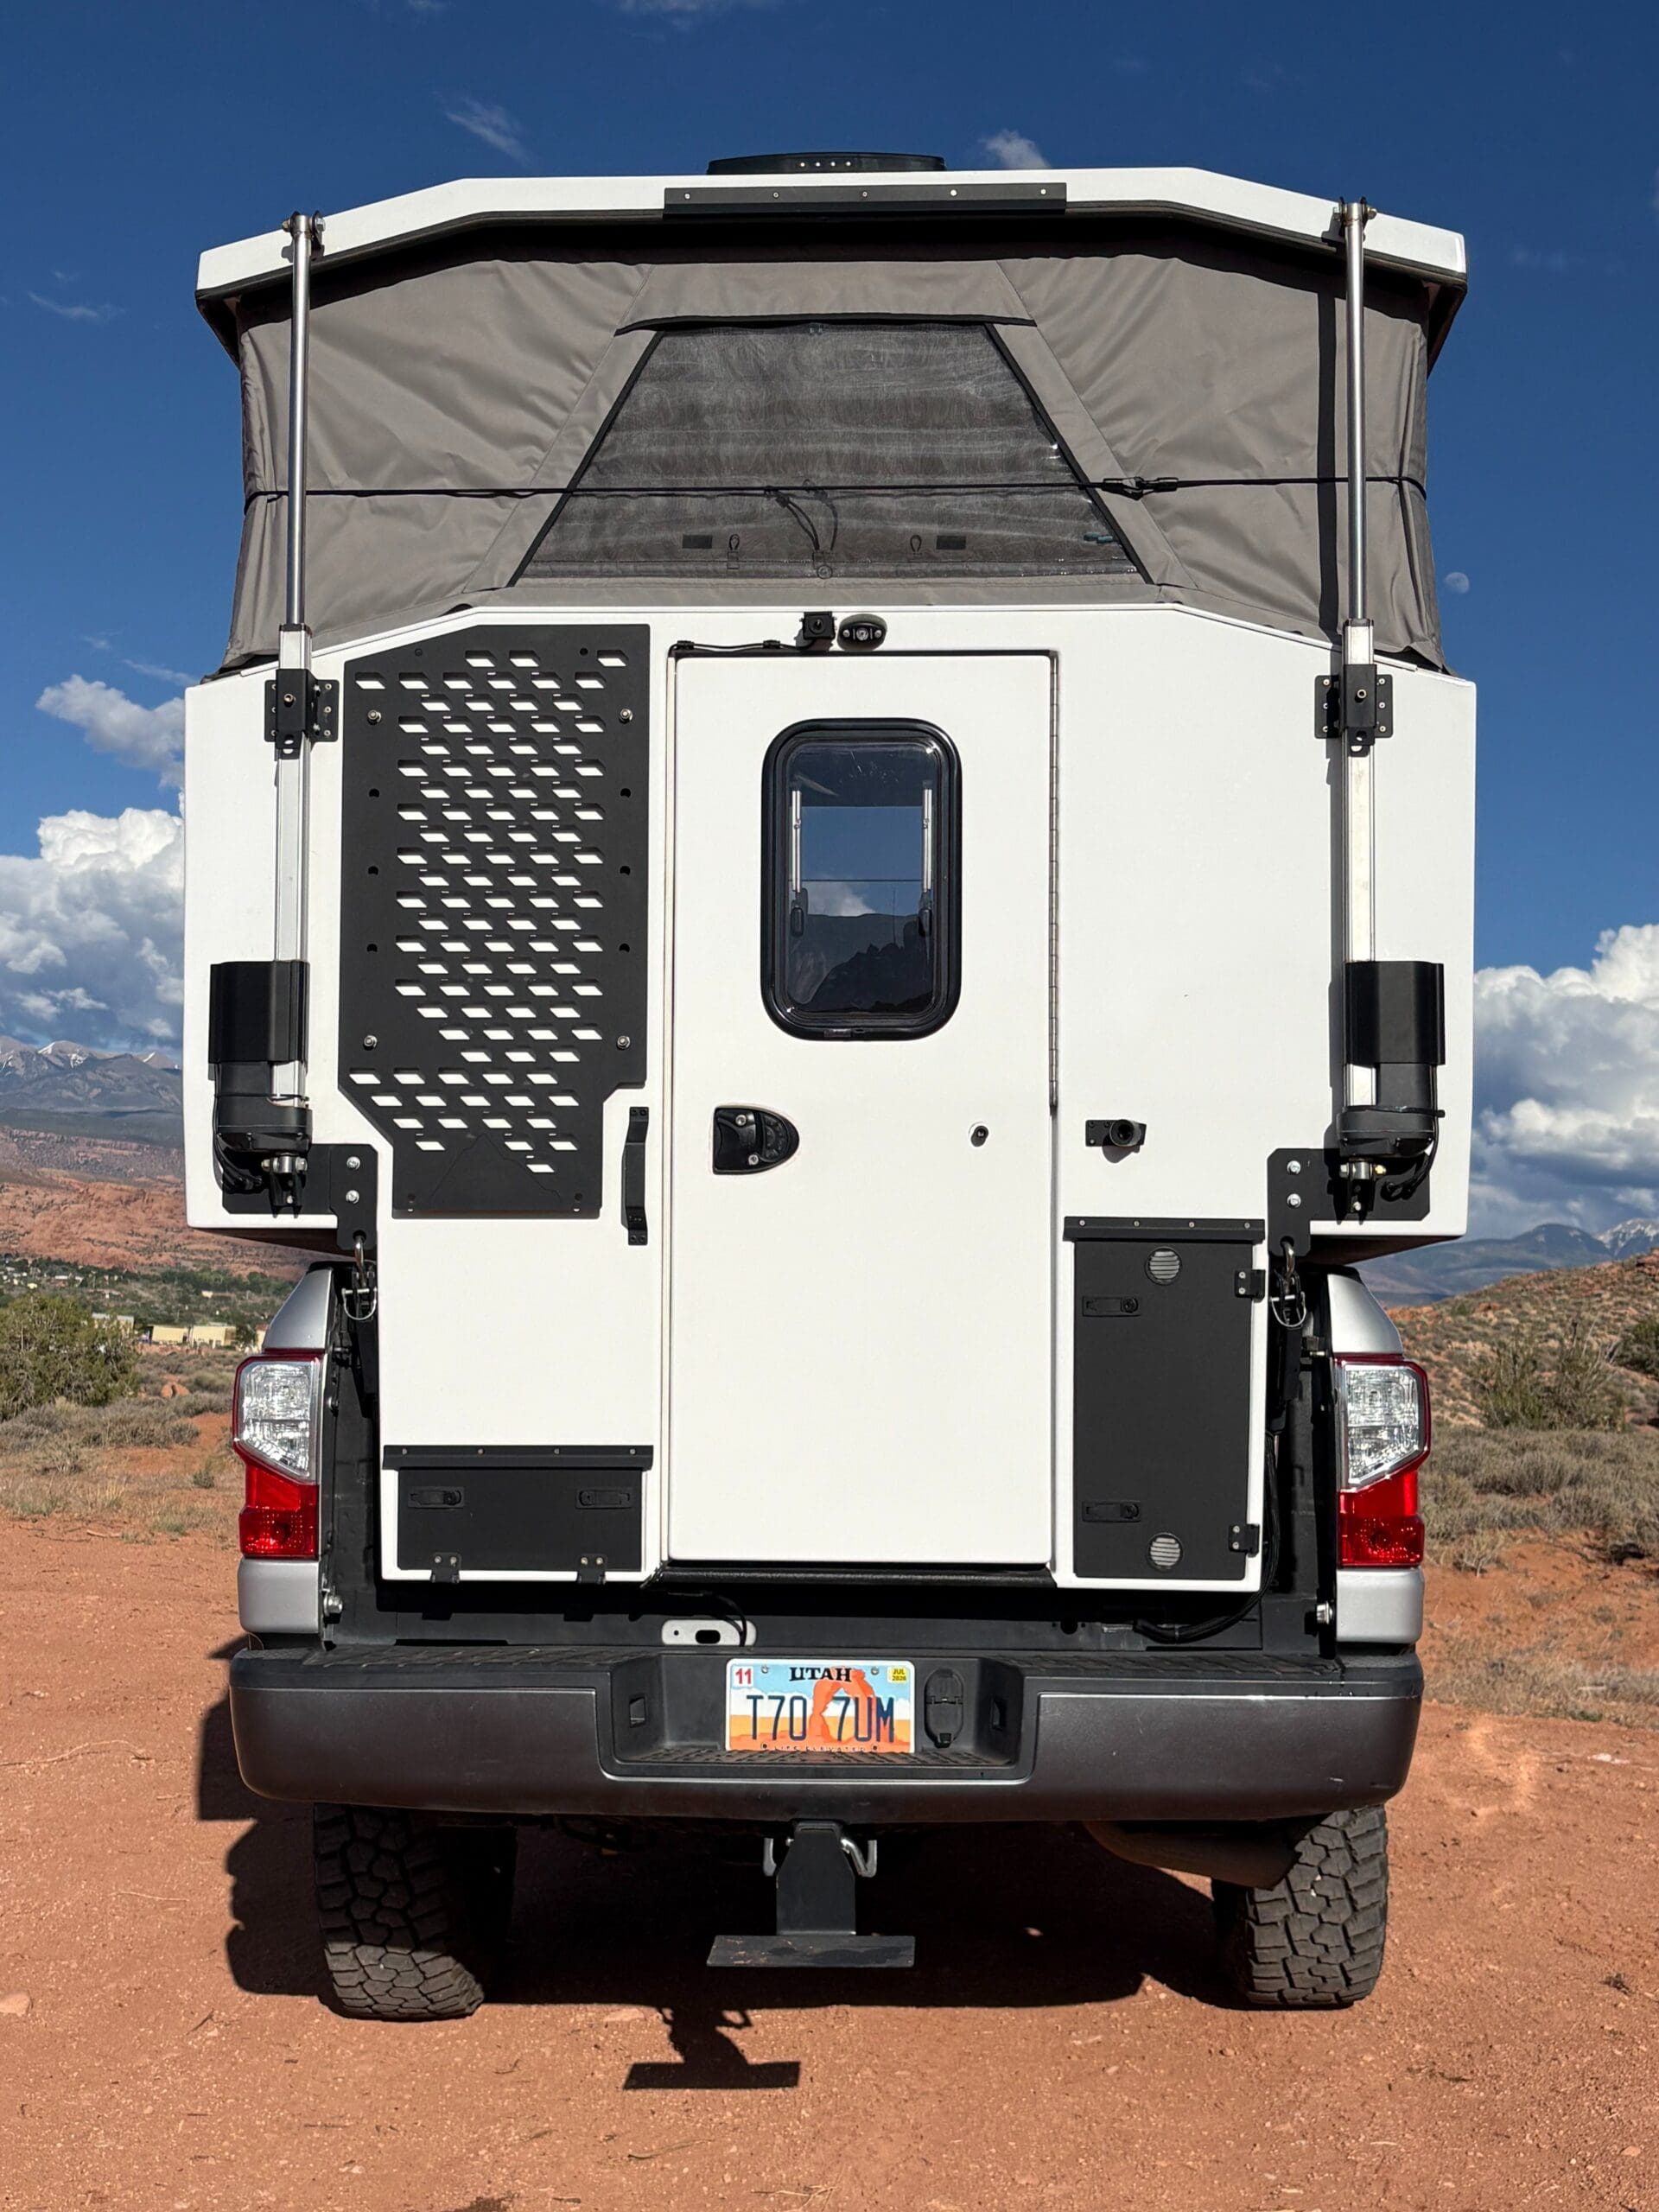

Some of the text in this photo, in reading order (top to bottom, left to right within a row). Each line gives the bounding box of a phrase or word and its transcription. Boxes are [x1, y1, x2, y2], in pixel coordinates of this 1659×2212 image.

[735, 1668, 752, 1684] 11
[789, 1667, 852, 1682] UTAH
[747, 1695, 894, 1743] T70 7UM
